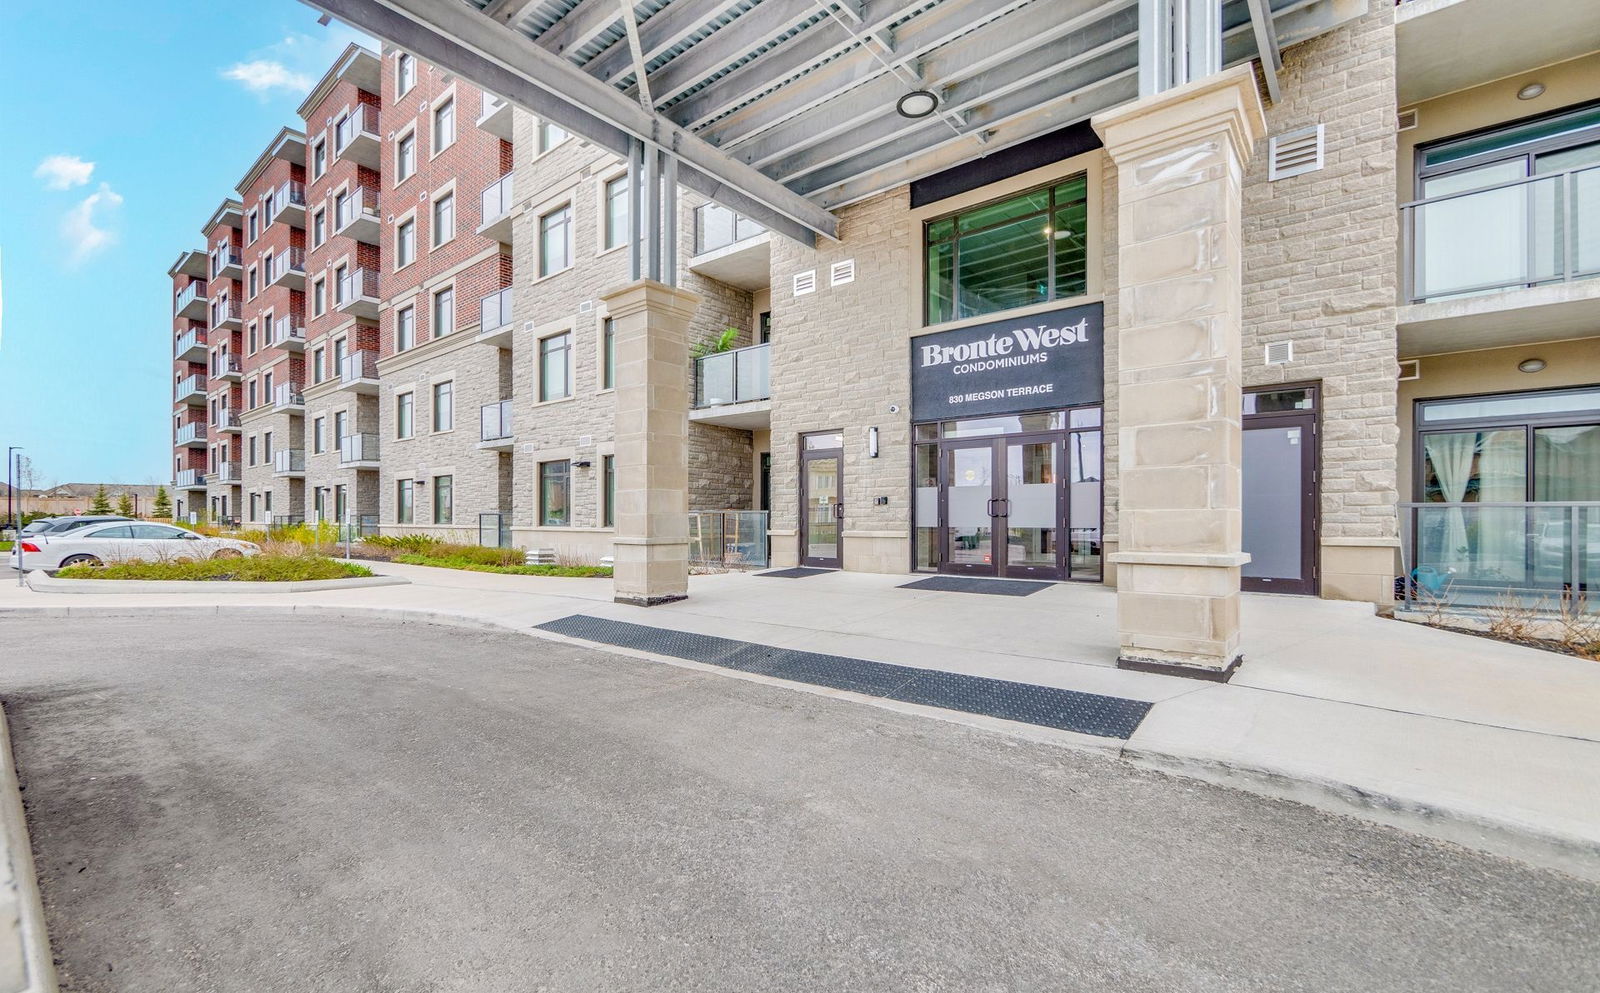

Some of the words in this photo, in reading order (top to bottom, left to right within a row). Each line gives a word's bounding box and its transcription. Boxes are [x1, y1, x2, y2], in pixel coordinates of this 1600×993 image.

[921, 334, 1013, 367] Bronte
[1013, 318, 1088, 351] West
[953, 352, 1048, 374] CONDOMINIUMS
[949, 395, 963, 404] 830
[965, 390, 1005, 402] MEGSON
[1007, 384, 1053, 397] TERRACE
